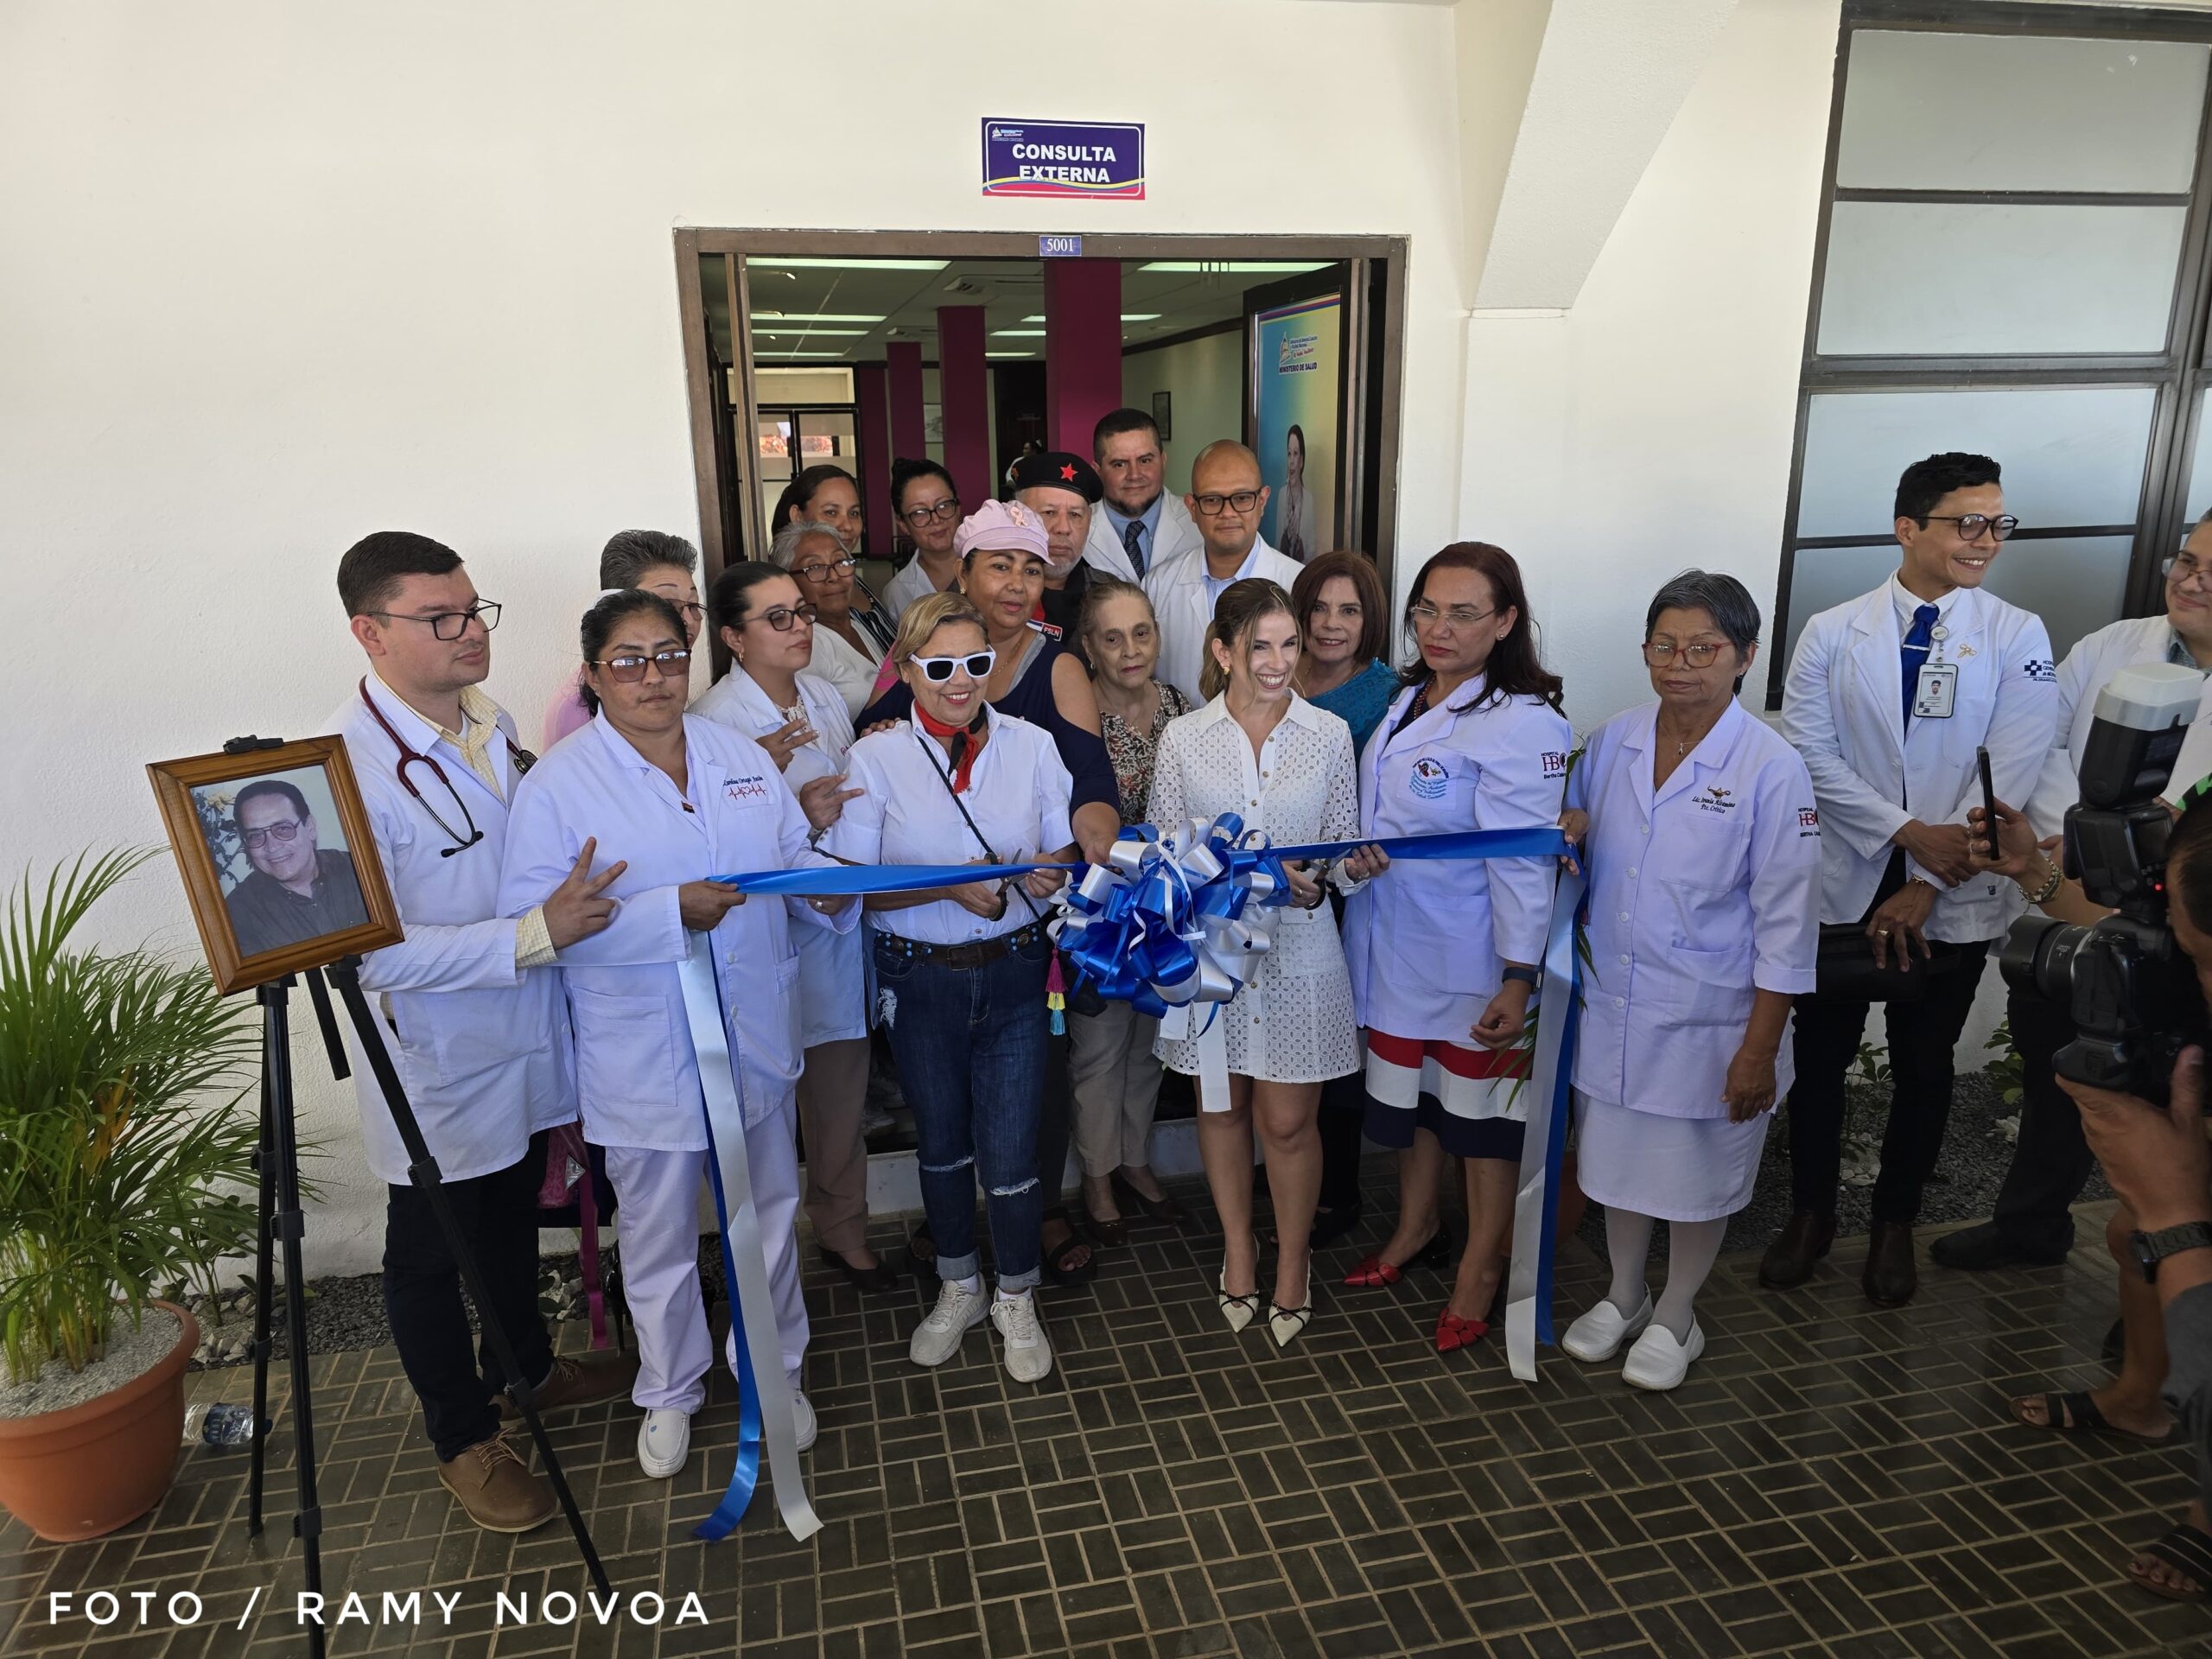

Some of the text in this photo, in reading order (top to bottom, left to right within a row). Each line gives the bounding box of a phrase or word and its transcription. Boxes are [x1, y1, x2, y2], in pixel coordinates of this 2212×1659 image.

[1012, 143, 1116, 162] CONSULTA
[1019, 165, 1110, 183] EXTERNA
[1046, 238, 1074, 252] 5001
[1279, 364, 1299, 373] MINISTERIO
[1043, 626, 1060, 638] FSLN
